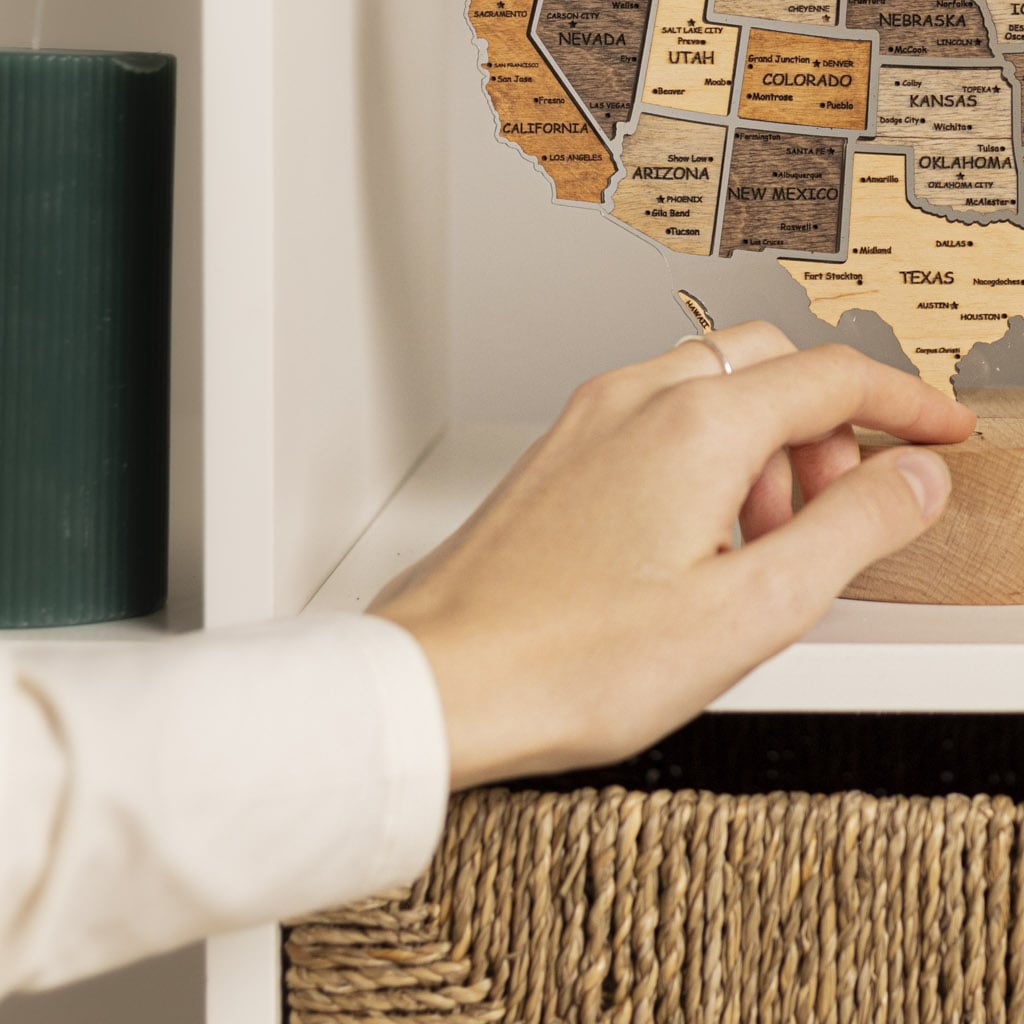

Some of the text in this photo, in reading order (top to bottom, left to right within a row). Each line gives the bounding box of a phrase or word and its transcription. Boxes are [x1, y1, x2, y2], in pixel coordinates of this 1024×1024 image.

[880, 14, 966, 27] NEBRASKA
[559, 33, 626, 46] NEVADA
[895, 46, 927, 54] McCook
[669, 51, 715, 64] UTAH
[748, 55, 810, 64] Grand Junction
[763, 74, 852, 87] COLORADO
[902, 80, 922, 88] Colby
[753, 93, 793, 101] Montrose
[910, 95, 977, 107] KANSAS
[827, 102, 853, 110] Pueblo
[503, 123, 588, 134] CALIFORNIA
[919, 156, 1012, 169] OKLAHOMA
[632, 167, 709, 180] ARIZONA
[728, 187, 838, 200] NEW MEXICO
[860, 246, 892, 254] Midland
[899, 271, 954, 284] TEXAS
